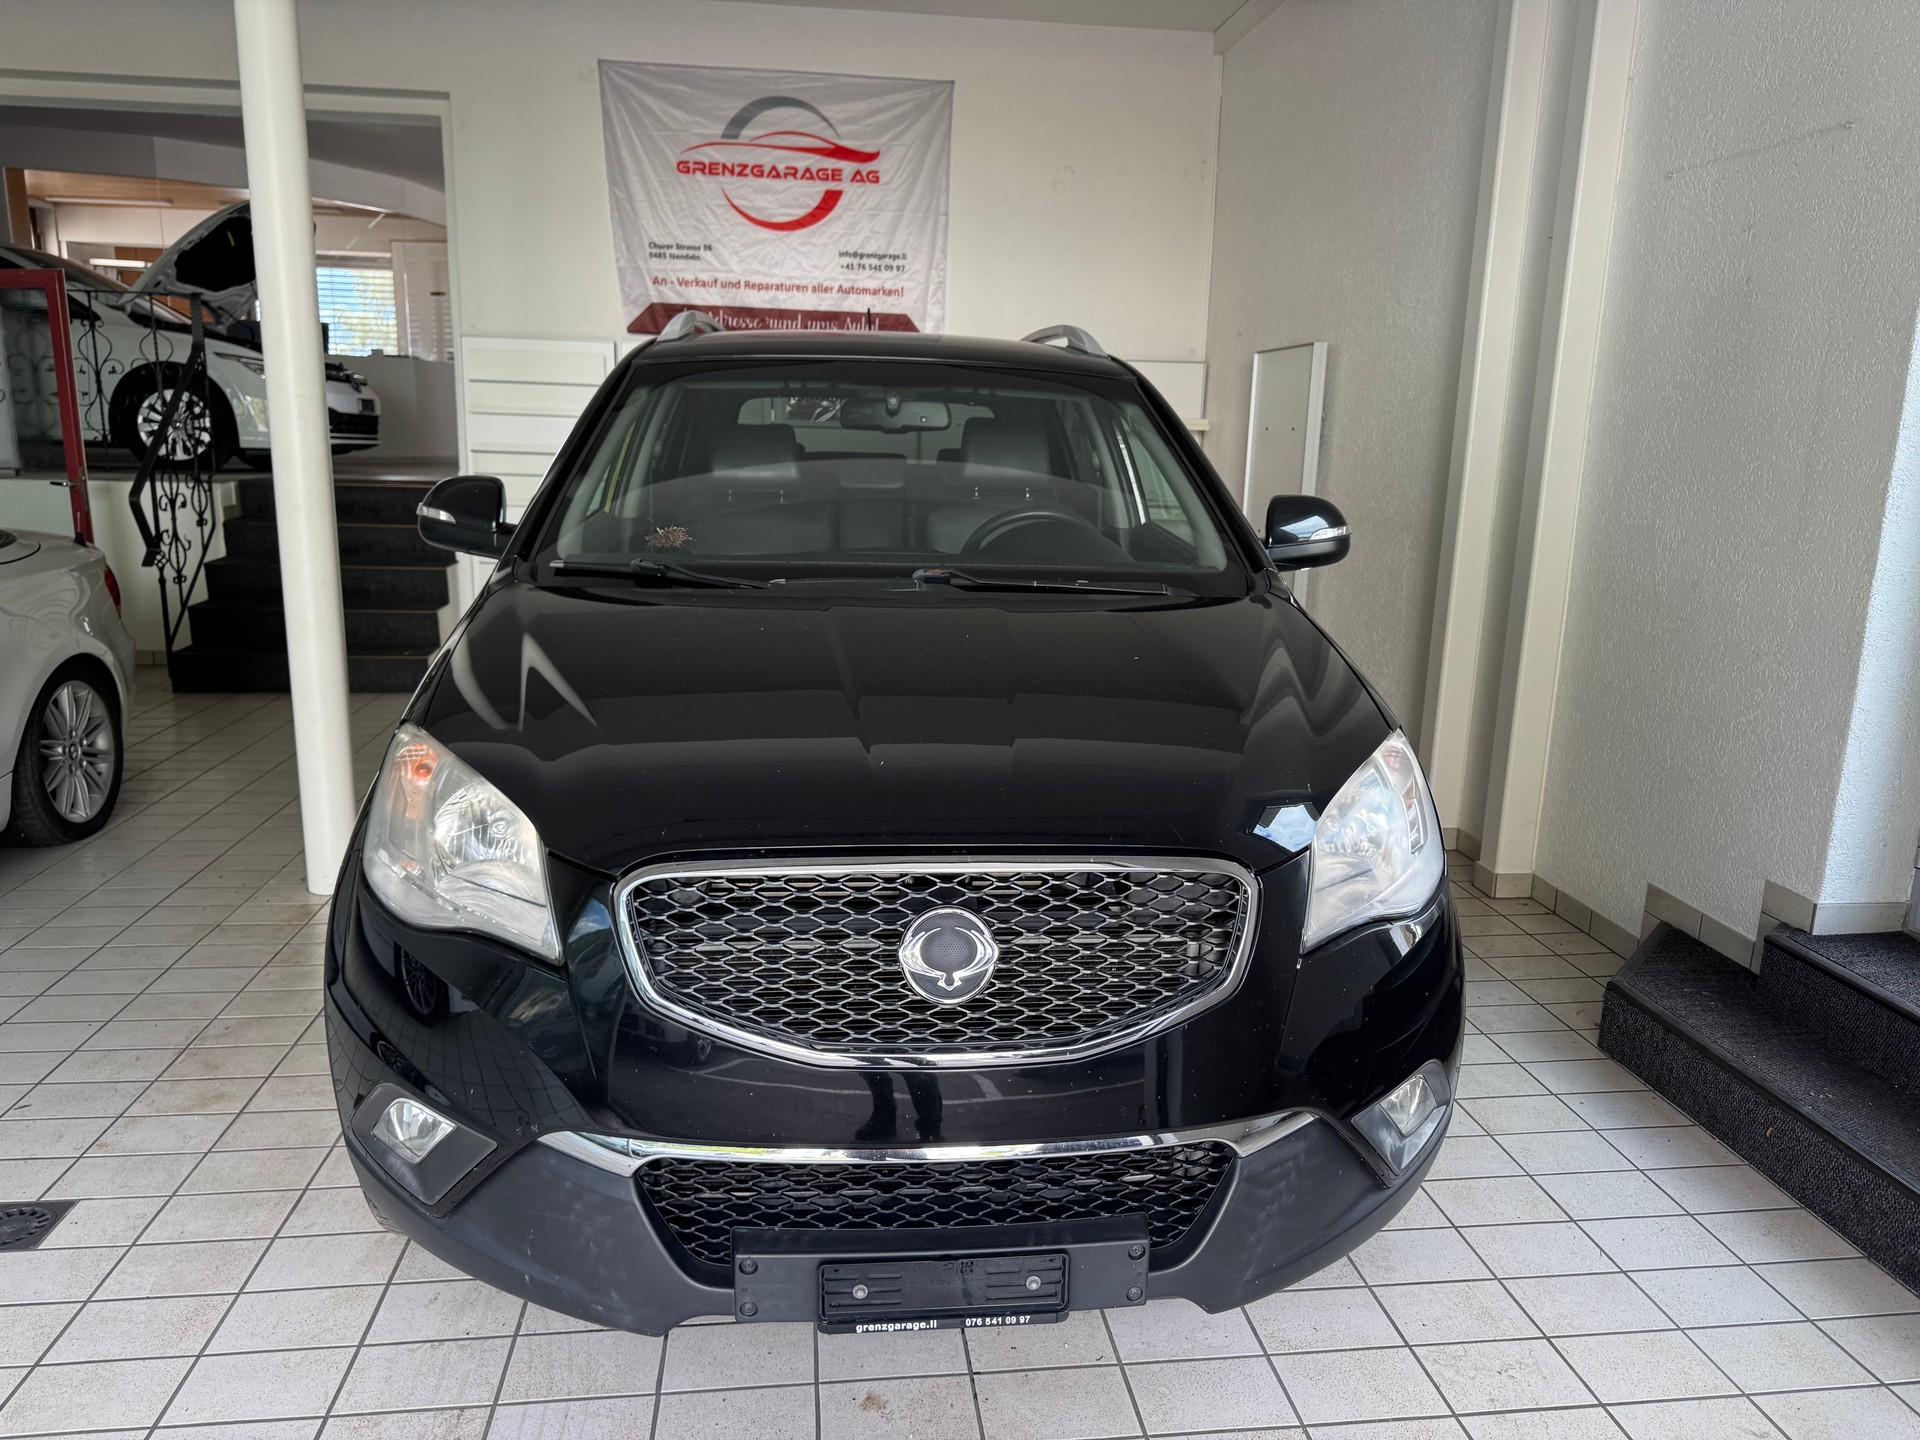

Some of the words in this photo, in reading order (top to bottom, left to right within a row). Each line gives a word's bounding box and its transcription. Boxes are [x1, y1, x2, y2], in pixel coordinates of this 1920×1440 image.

[676, 160, 843, 182] GRENZGARAGE
[850, 169, 880, 184] AG
[841, 263, 854, 271] +41
[857, 263, 867, 271] 76
[868, 263, 882, 272] 541
[884, 264, 894, 272] 09
[896, 264, 906, 272] 97
[653, 276, 667, 286] An
[677, 277, 718, 288] Verkauf
[721, 280, 740, 289] und
[744, 280, 808, 293] Reparaturen
[811, 283, 834, 294] aller
[837, 284, 904, 297] Automarken!
[856, 1320, 937, 1333] grenzgarage.li
[965, 1317, 982, 1327] 076
[985, 1316, 1002, 1326] 541
[1005, 1316, 1016, 1325] 09
[1019, 1315, 1031, 1324] 97
